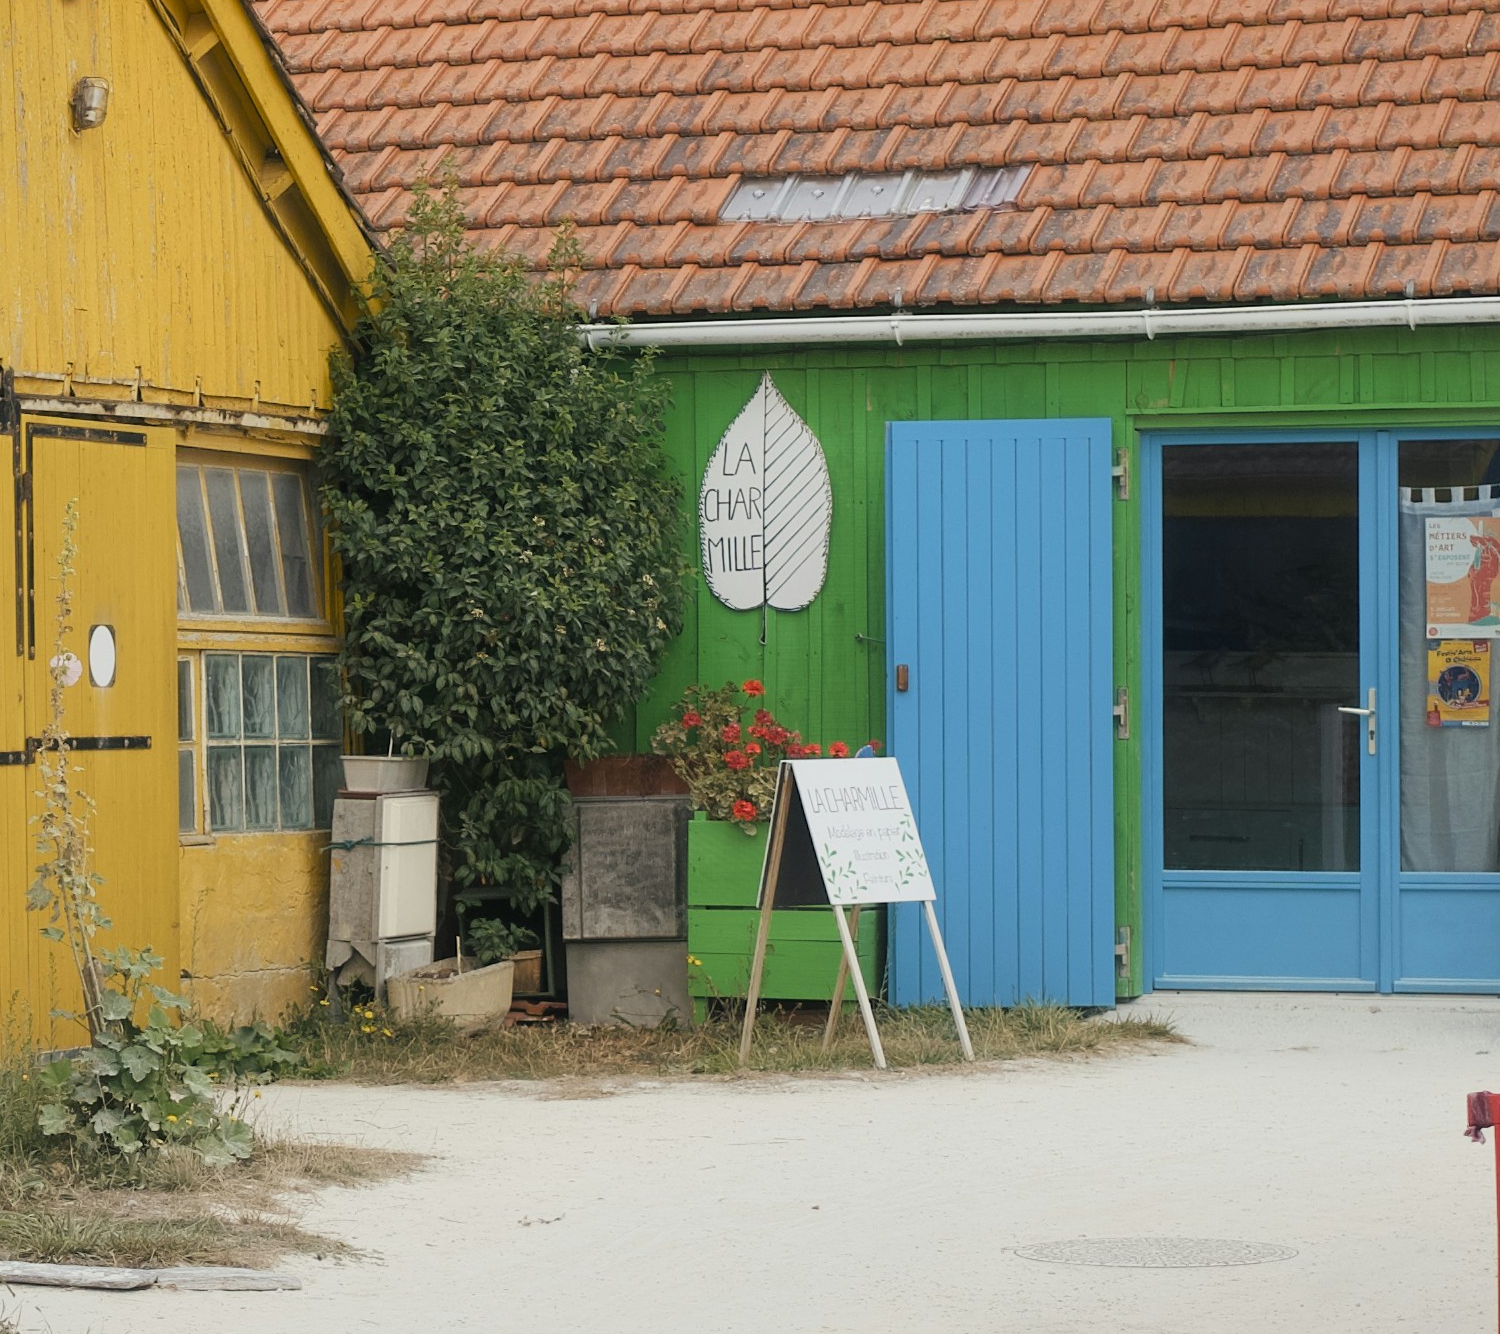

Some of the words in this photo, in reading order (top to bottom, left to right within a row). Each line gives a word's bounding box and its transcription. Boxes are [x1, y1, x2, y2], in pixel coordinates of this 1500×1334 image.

[722, 442, 756, 476] LA
[703, 486, 762, 522] CHAR
[707, 534, 763, 574] MILLE
[1428, 543, 1454, 552] D'ART
[807, 787, 827, 814] LA
[824, 785, 905, 813] CHARMILLE
